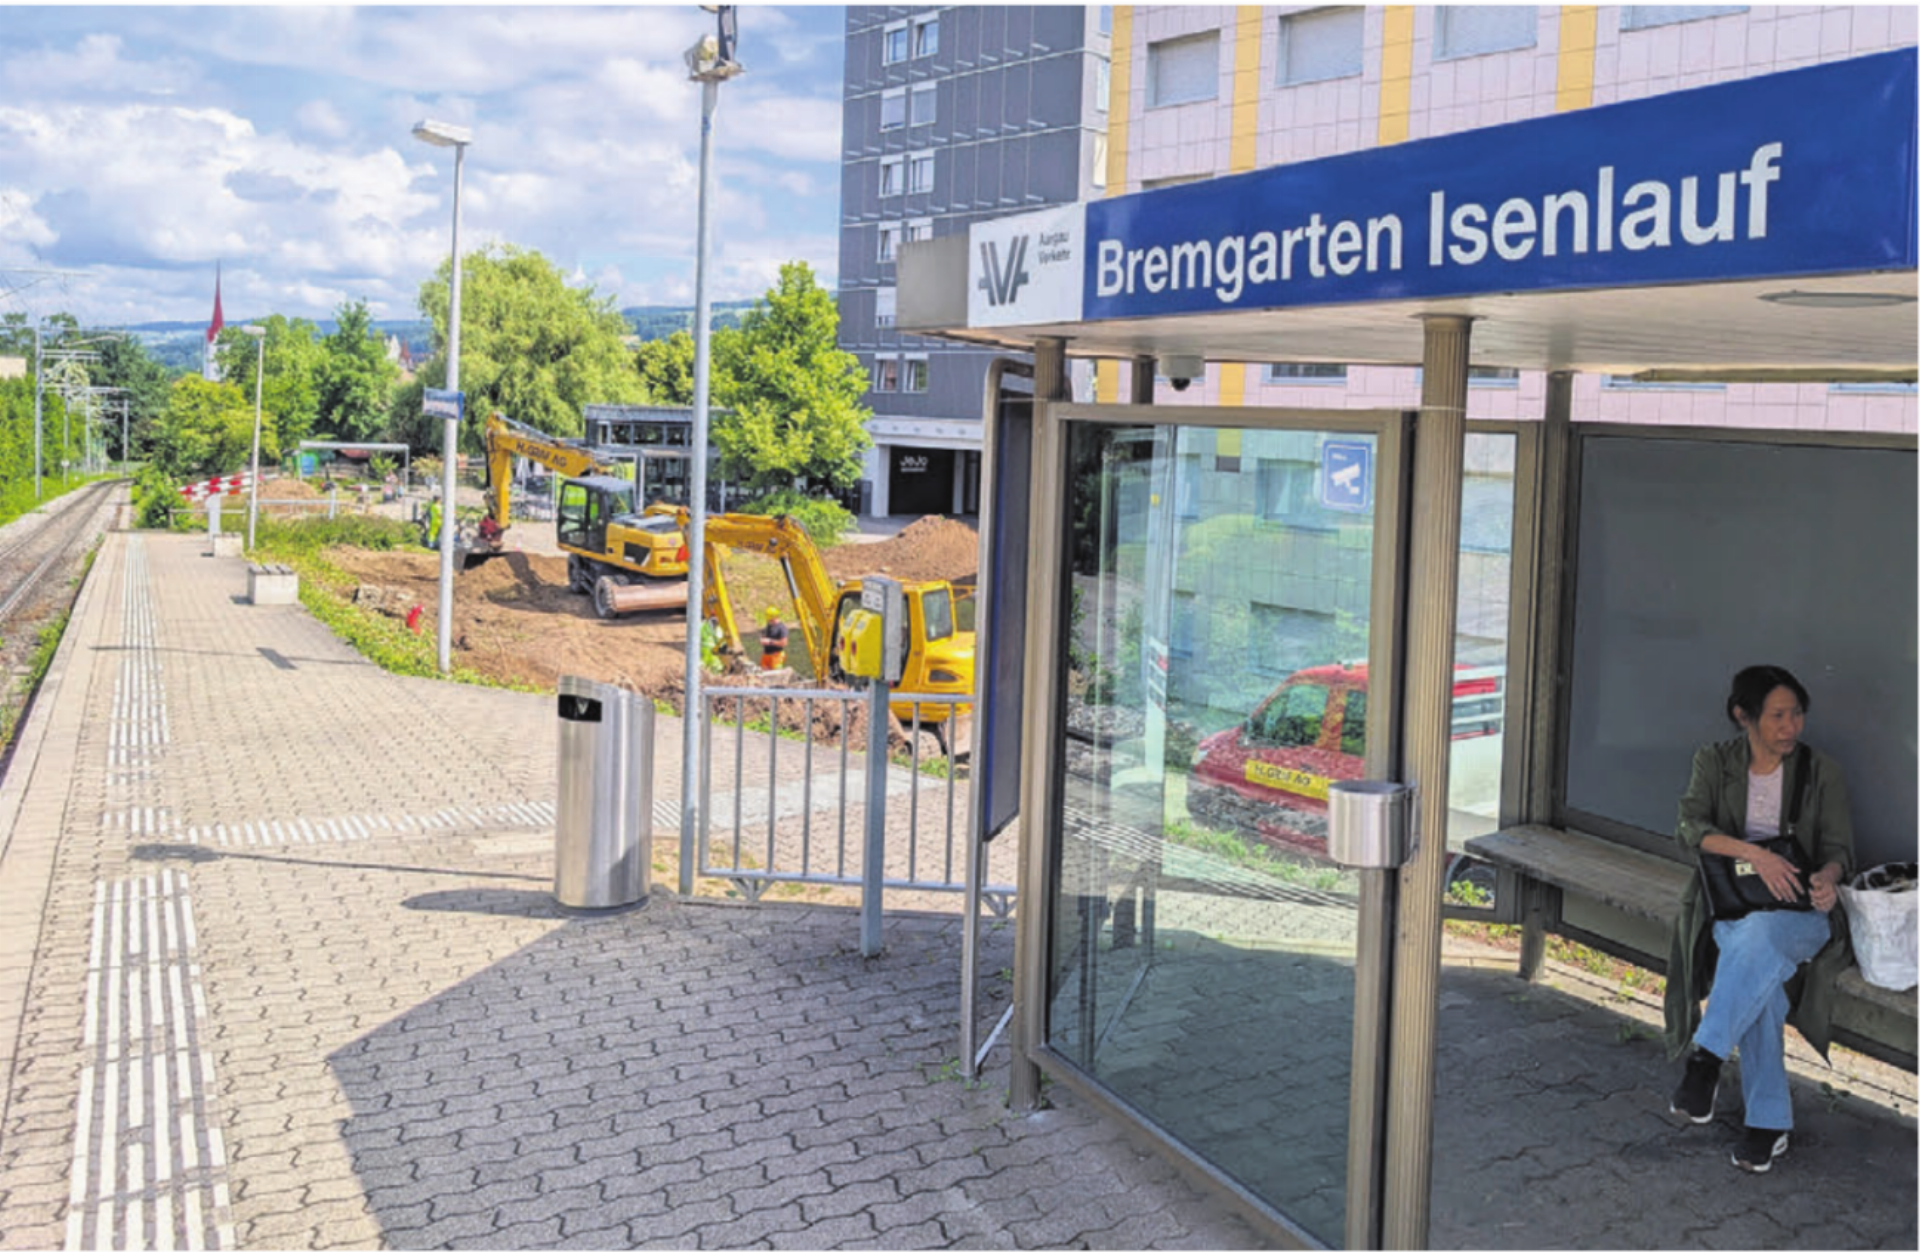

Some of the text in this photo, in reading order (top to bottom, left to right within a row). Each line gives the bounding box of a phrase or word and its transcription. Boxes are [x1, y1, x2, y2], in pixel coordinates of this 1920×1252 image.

[1097, 142, 1783, 303] Bremgarten Isenlauf
[1039, 232, 1069, 247] Aargau
[1039, 248, 1070, 265] Verkehr
